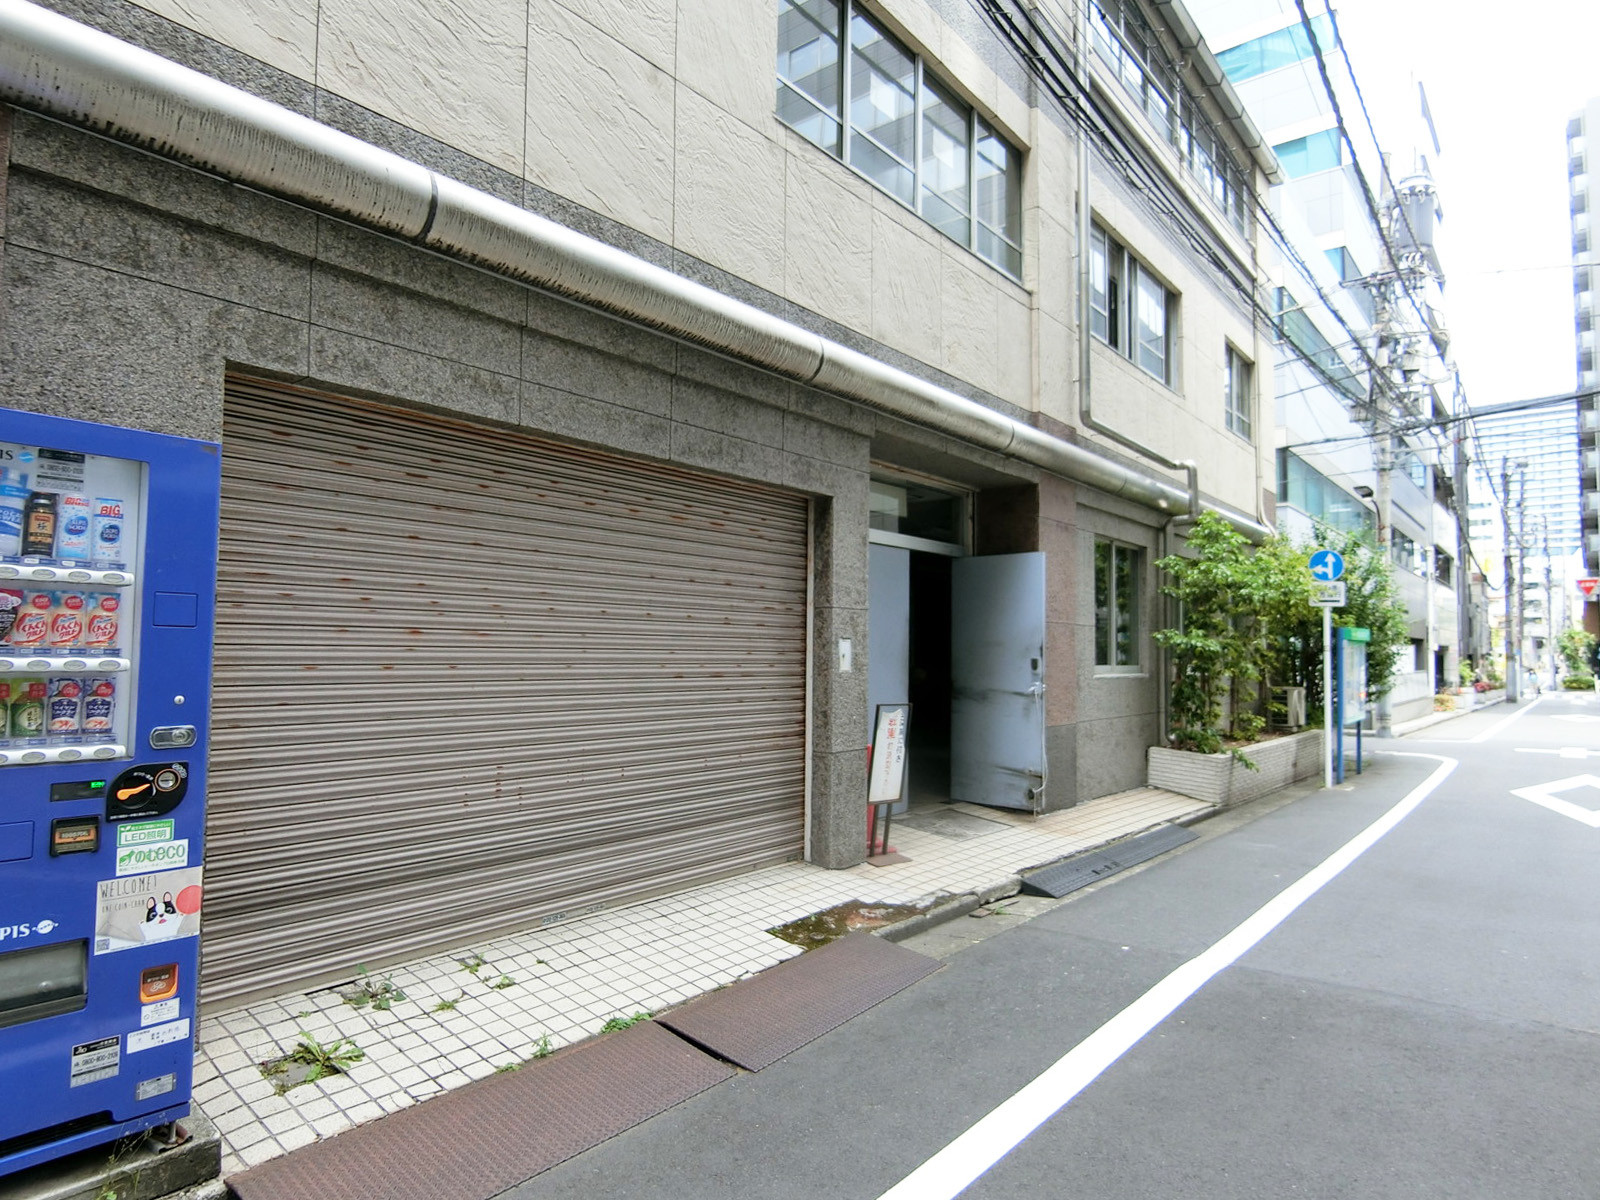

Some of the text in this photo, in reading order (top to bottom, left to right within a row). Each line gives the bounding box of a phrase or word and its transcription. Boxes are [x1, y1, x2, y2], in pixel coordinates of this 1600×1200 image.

[100, 503, 121, 516] BIG
[124, 829, 167, 842] LED照明
[135, 844, 185, 863] のむeco
[100, 875, 157, 898] WELCOME!
